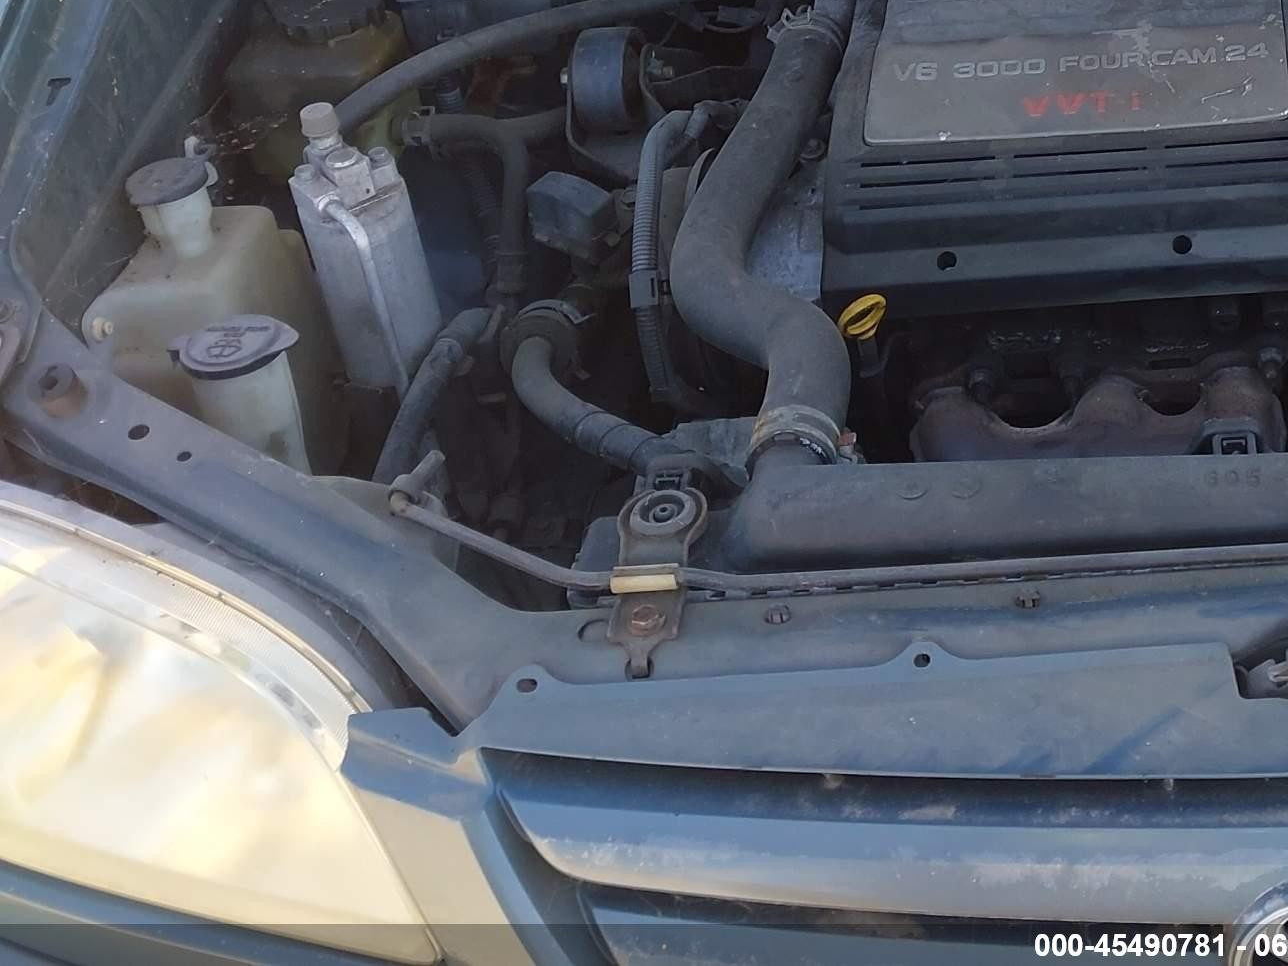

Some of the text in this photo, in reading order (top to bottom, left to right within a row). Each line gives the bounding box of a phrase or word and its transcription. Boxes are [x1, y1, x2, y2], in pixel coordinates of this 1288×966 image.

[893, 42, 1269, 82] V6 3000 FOUR CAM 24
